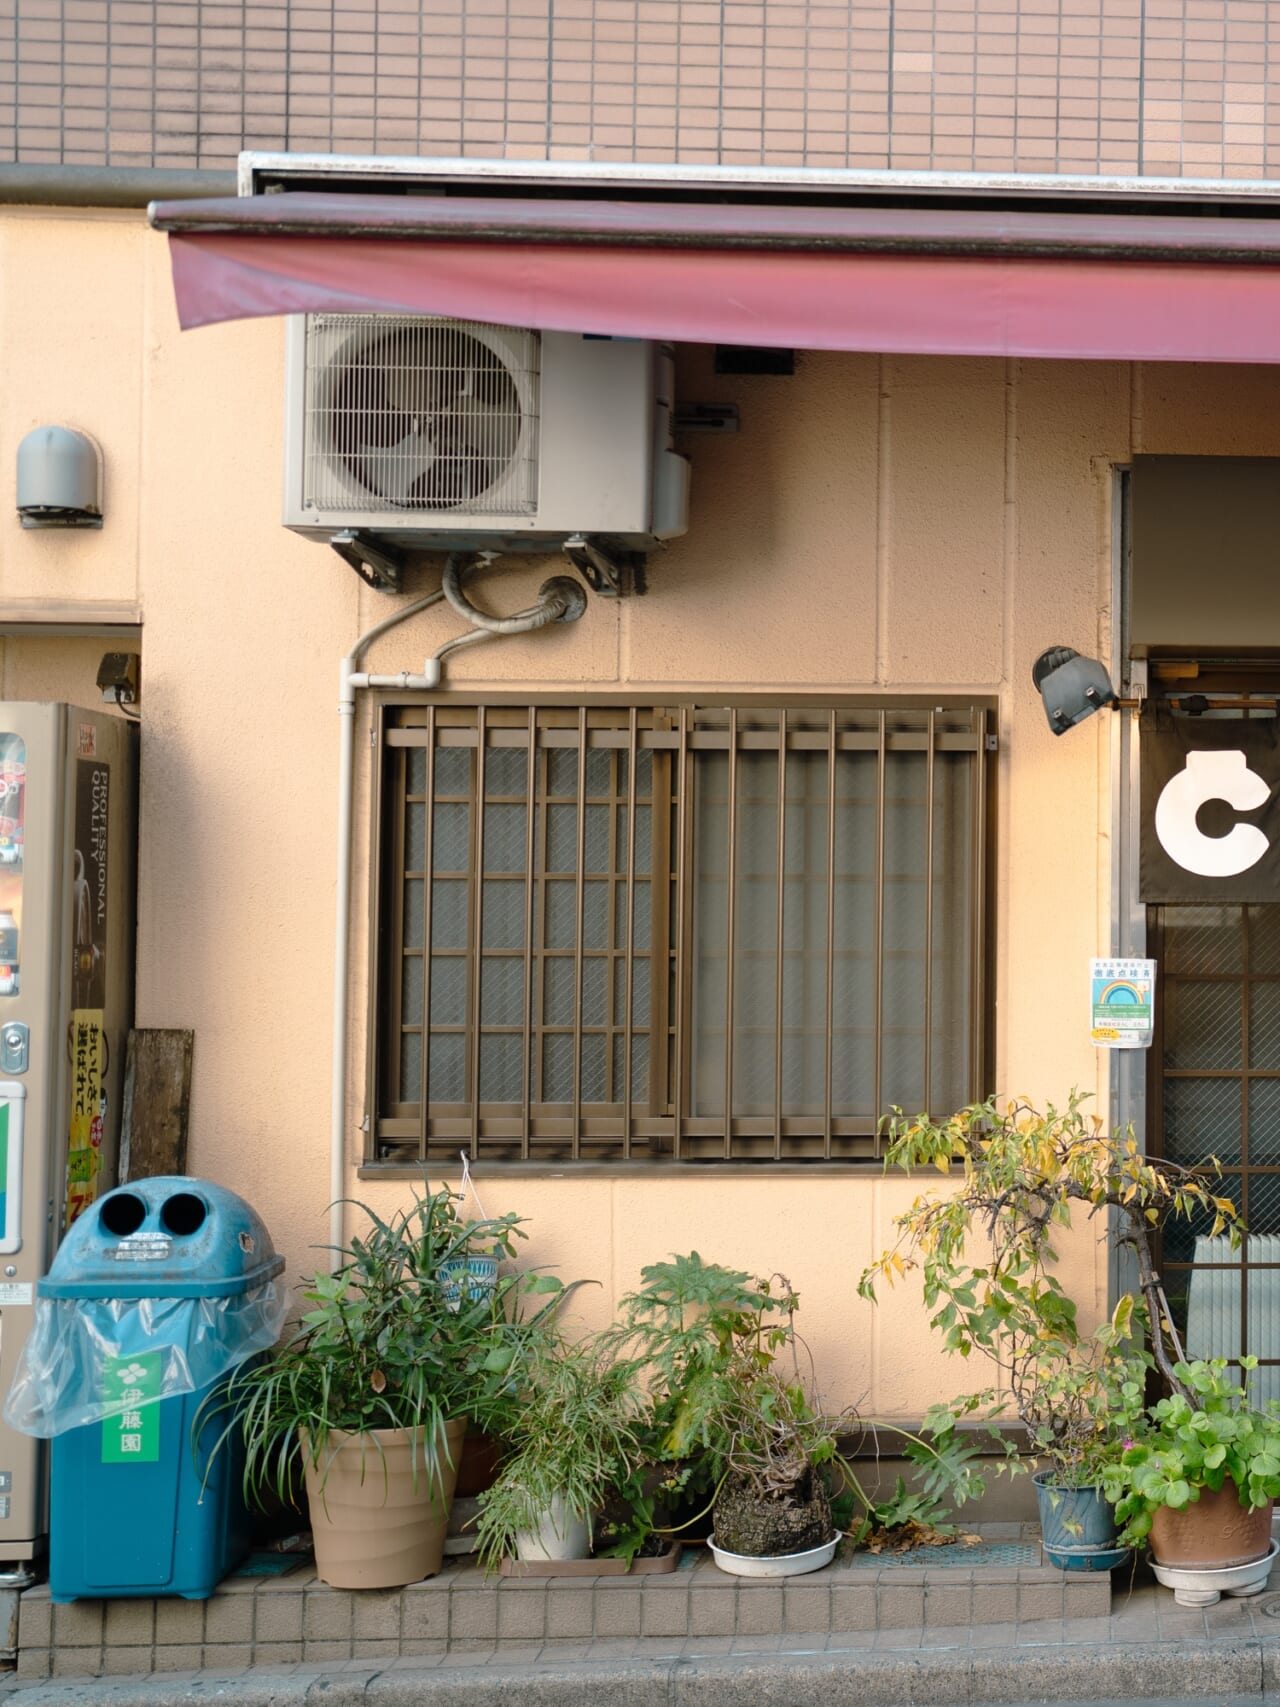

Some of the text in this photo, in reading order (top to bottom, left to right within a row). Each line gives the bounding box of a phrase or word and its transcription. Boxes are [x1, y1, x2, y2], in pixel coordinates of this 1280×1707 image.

[91, 770, 100, 861] QUALITY
[97, 771, 108, 925] PROFESSIONAL
[87, 1023, 99, 1117] おいしさで
[119, 1388, 143, 1453] 伊藤園
